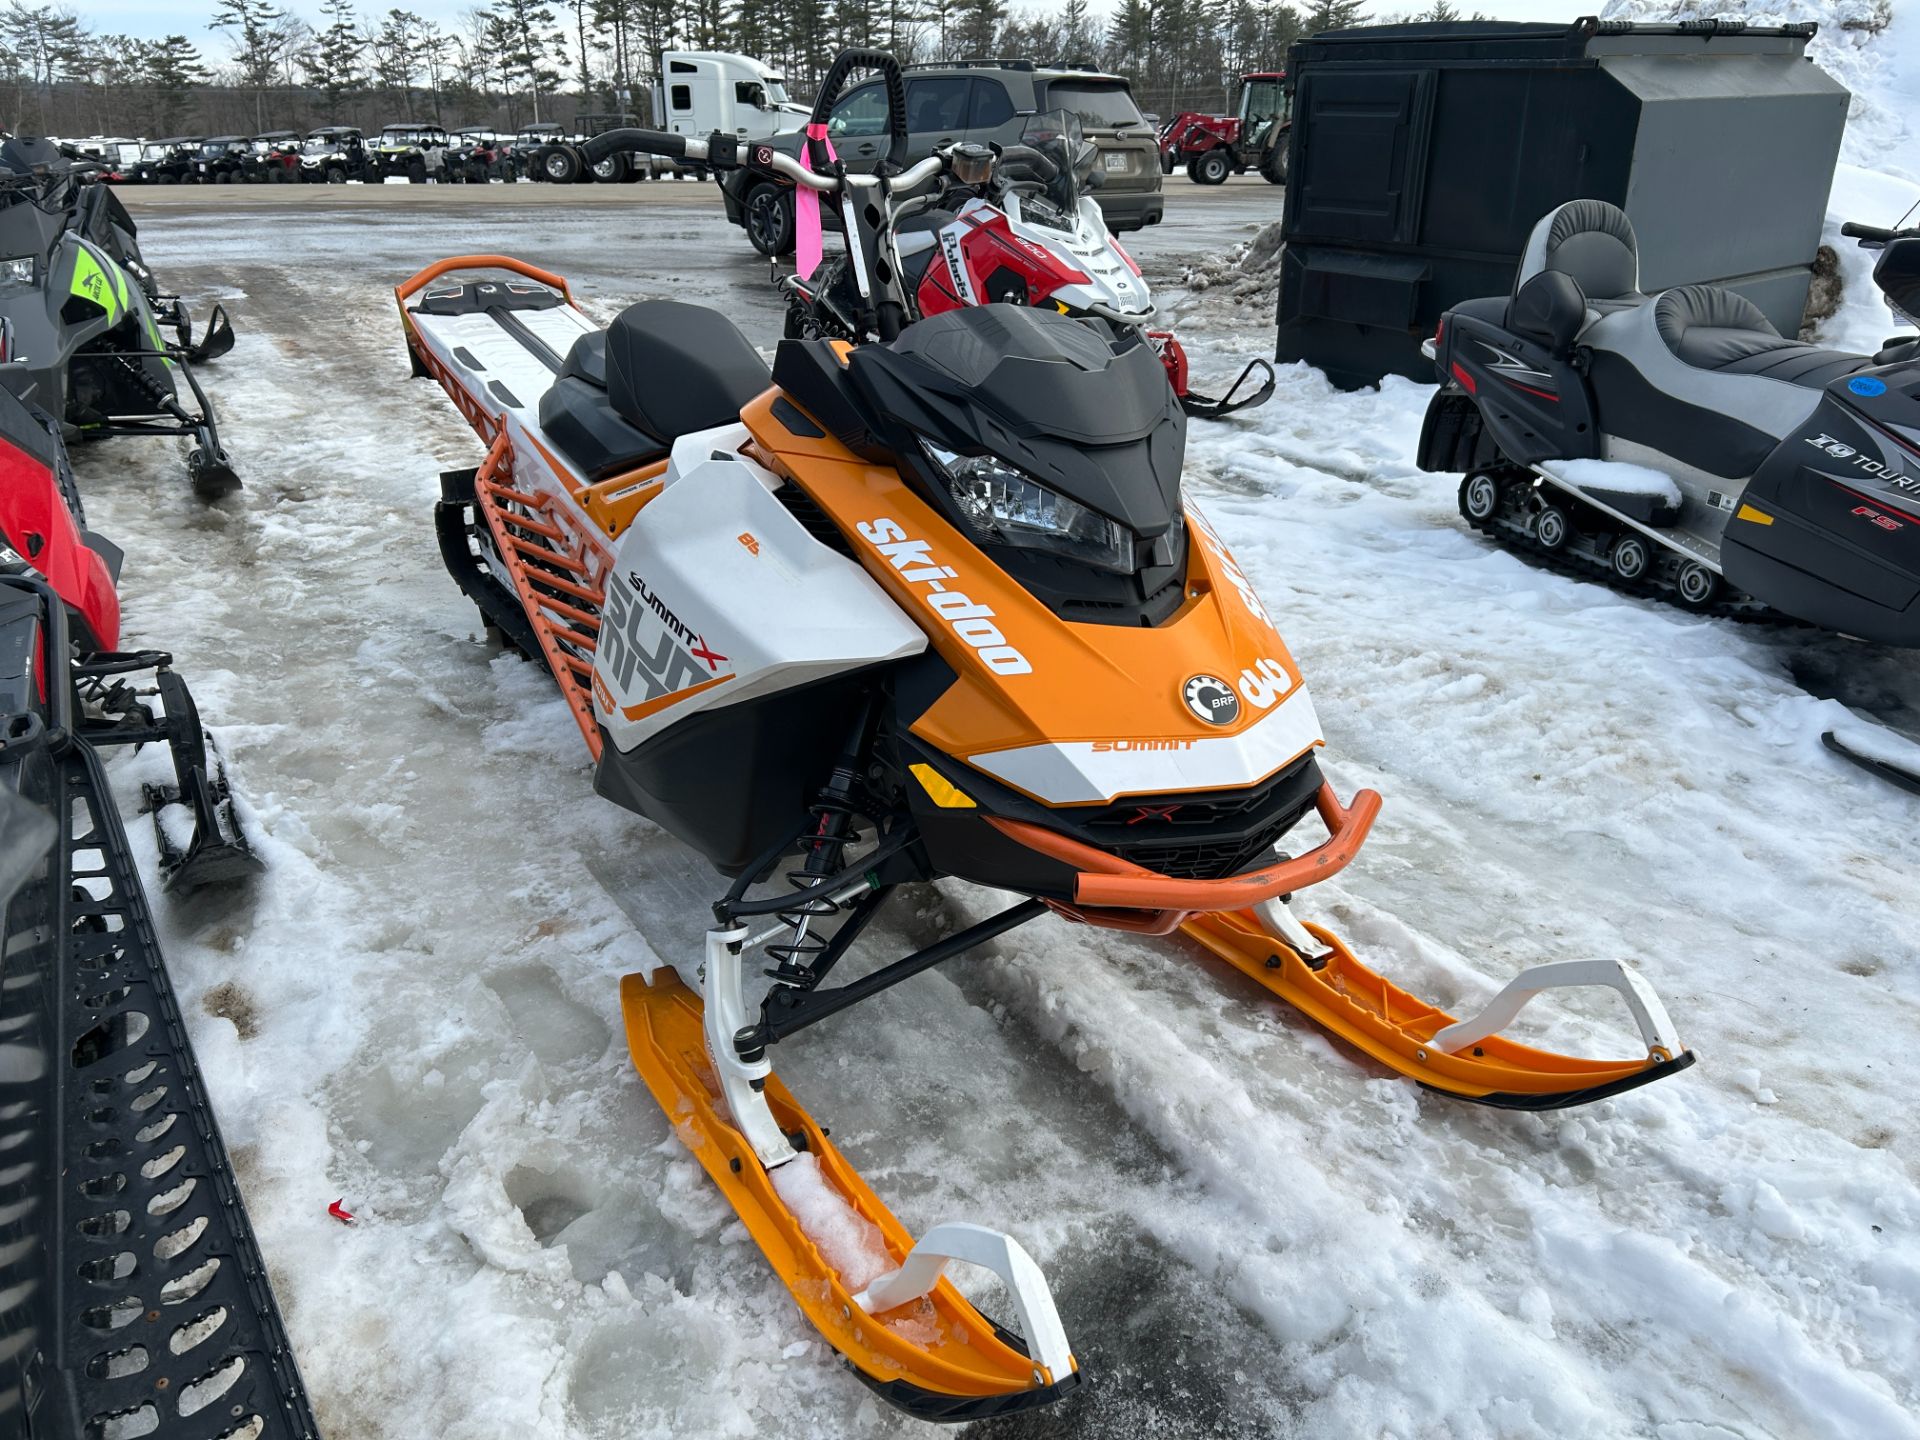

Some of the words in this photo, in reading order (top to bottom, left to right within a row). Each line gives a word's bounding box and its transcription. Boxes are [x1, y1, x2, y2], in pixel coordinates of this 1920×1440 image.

[942, 230, 969, 298] Polaris
[1804, 433, 1857, 458] IQ
[1851, 506, 1903, 531] FS
[628, 570, 698, 647] SUMMIT
[690, 633, 729, 672] X
[1211, 696, 1236, 709] BRP
[1091, 739, 1198, 753] SUMMIT
